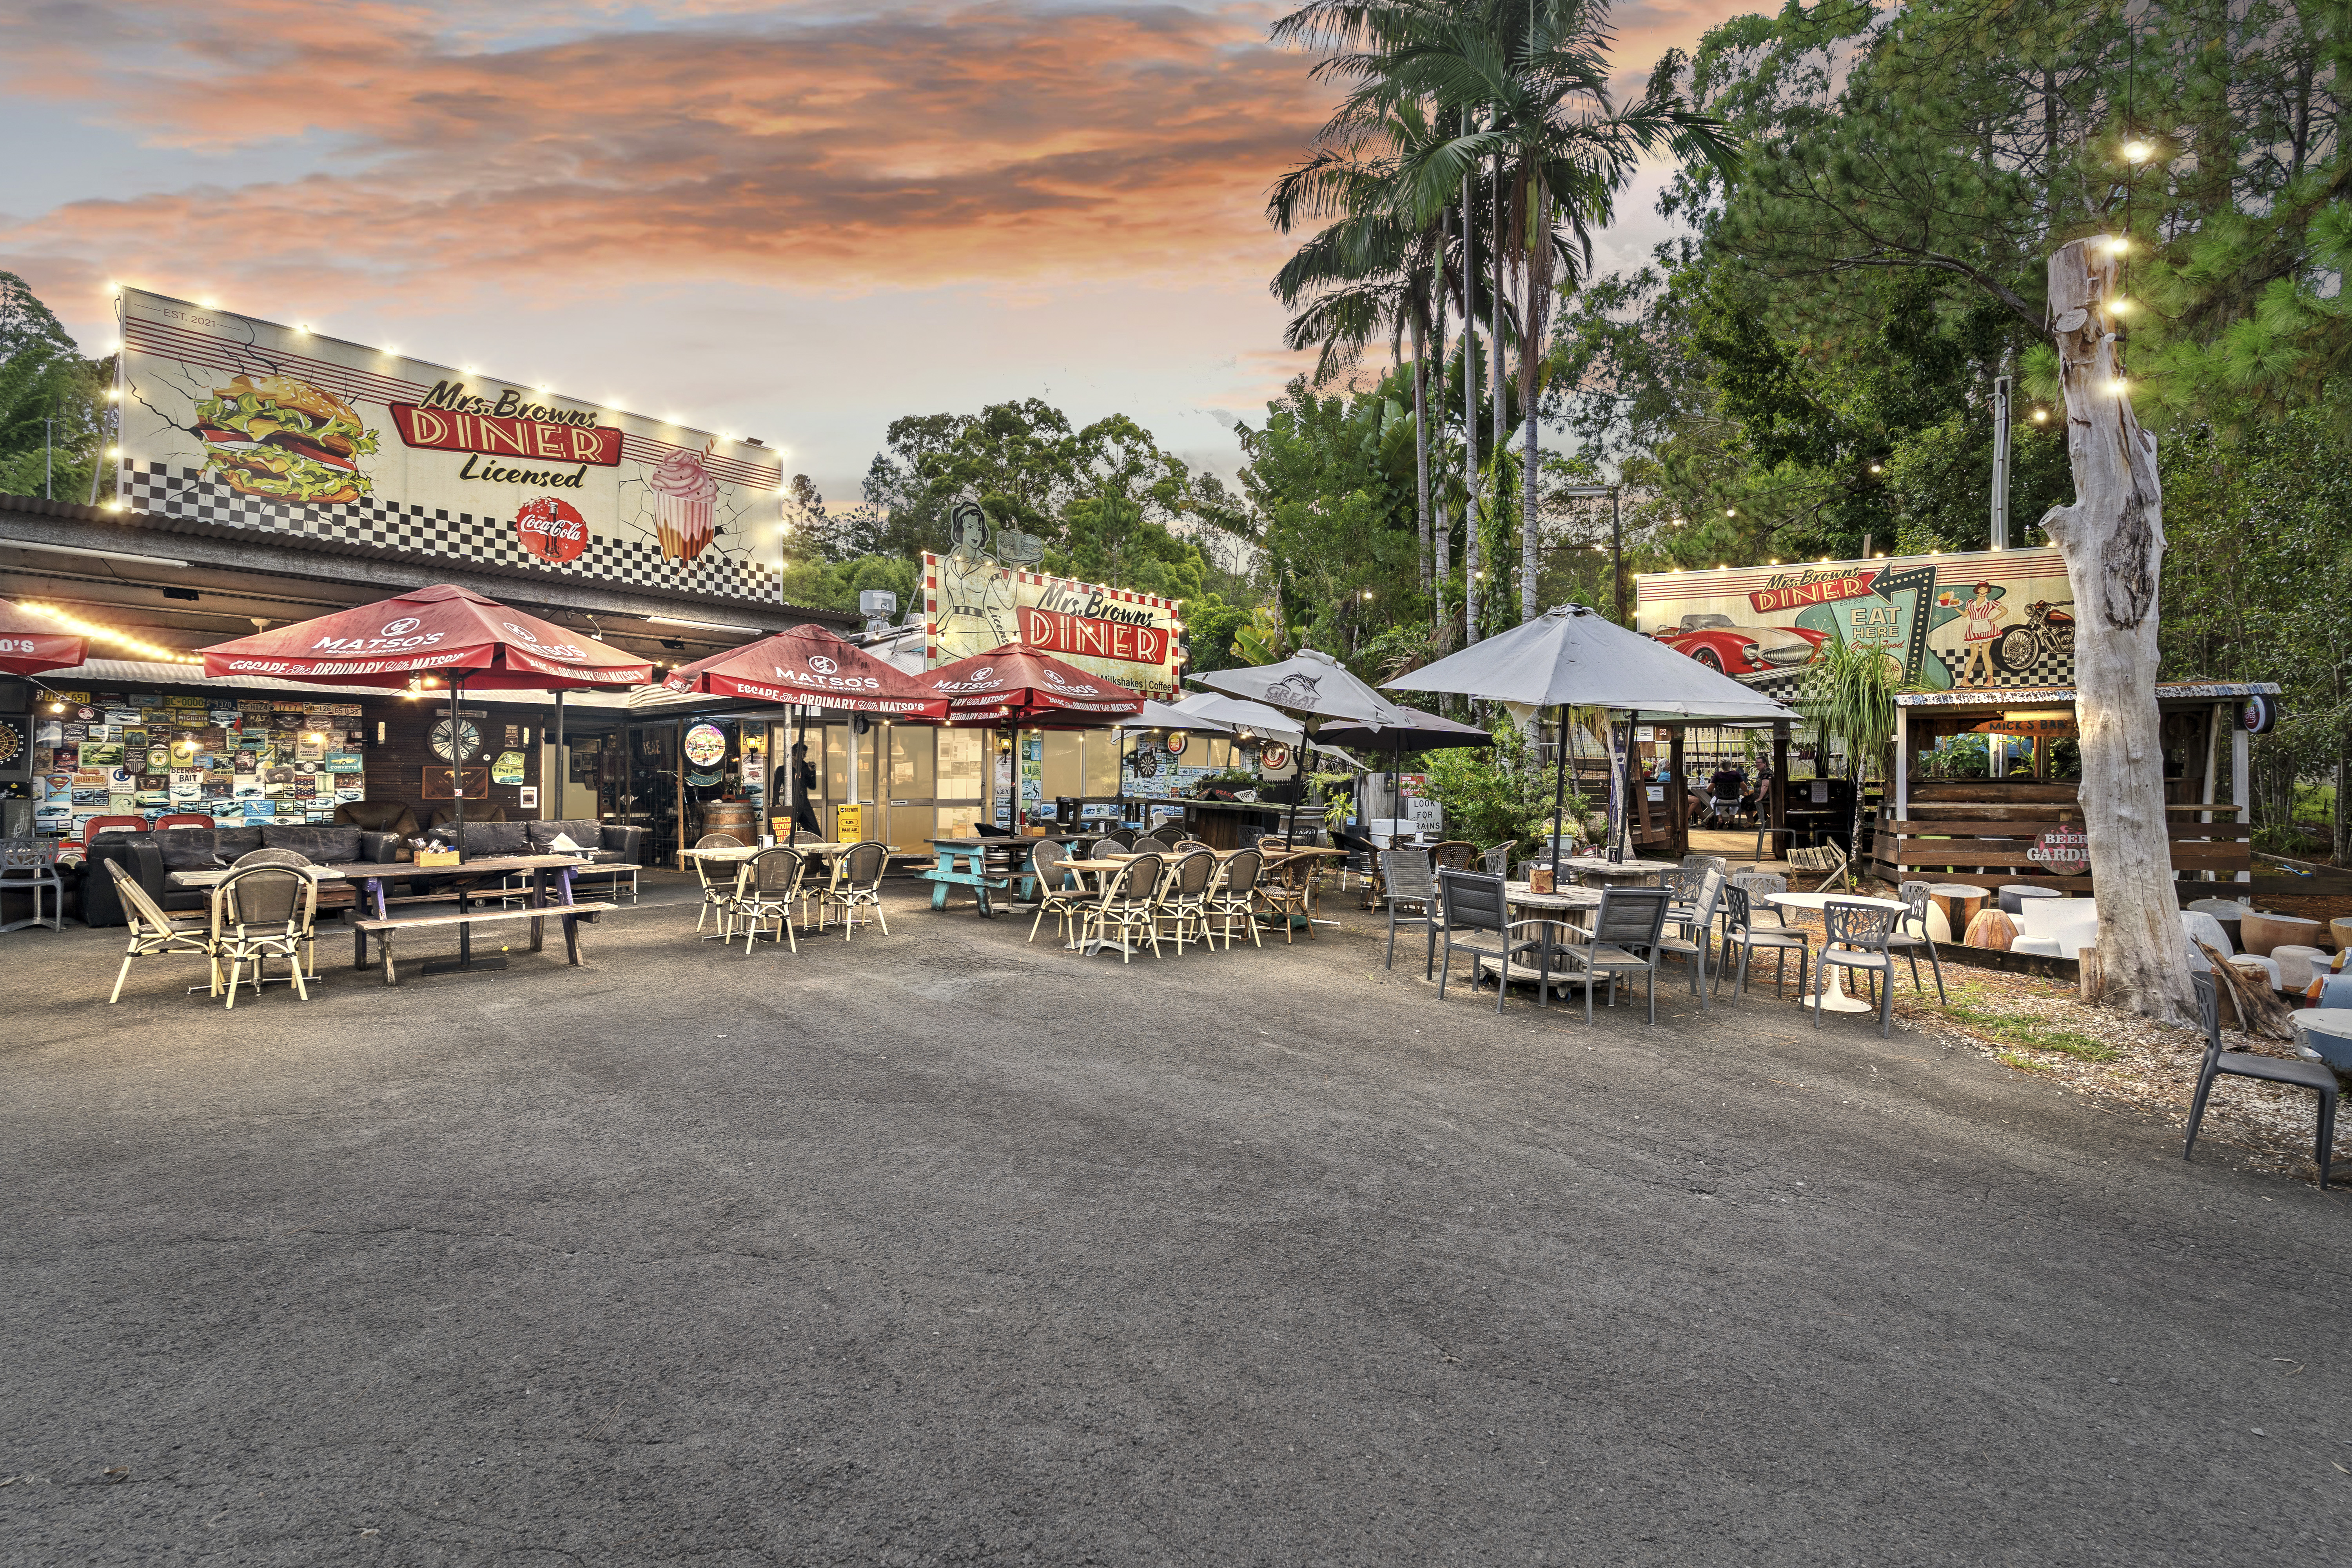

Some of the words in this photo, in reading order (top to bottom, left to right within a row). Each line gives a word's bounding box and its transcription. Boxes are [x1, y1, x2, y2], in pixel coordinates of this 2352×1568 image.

[163, 309, 188, 322] EST.
[191, 316, 216, 328] 2021
[411, 409, 603, 462] DINER
[460, 452, 587, 488] Licensed
[1759, 578, 1863, 610] DINER
[1851, 607, 1902, 626] EAT
[987, 606, 1010, 644] Licens
[1853, 626, 1899, 639] HERE
[310, 632, 445, 649] MATSO'S
[1030, 611, 1158, 662] DINER
[229, 660, 289, 673] ESCAPE
[286, 665, 311, 674] The
[310, 661, 385, 675] ORDINARY
[385, 661, 409, 671] With
[595, 671, 610, 681] With
[775, 666, 880, 688] MATSO'S
[932, 679, 1004, 689] MATSO'S
[1149, 680, 1171, 691] Coffee
[738, 683, 779, 700] ESCAPE
[780, 693, 799, 702] The
[799, 693, 856, 710] ORDINARY
[858, 700, 878, 710] With
[880, 701, 924, 712] MATSO'S
[1267, 686, 1321, 706] GREAT
[2040, 720, 2066, 730] BAR
[125, 762, 145, 772] MOTORS
[692, 773, 721, 783] WELCOME
[1216, 789, 1234, 799] PEACE
[1240, 790, 1254, 800] HOPE
[2045, 834, 2088, 844] BEER
[2027, 848, 2091, 861] GARDE
